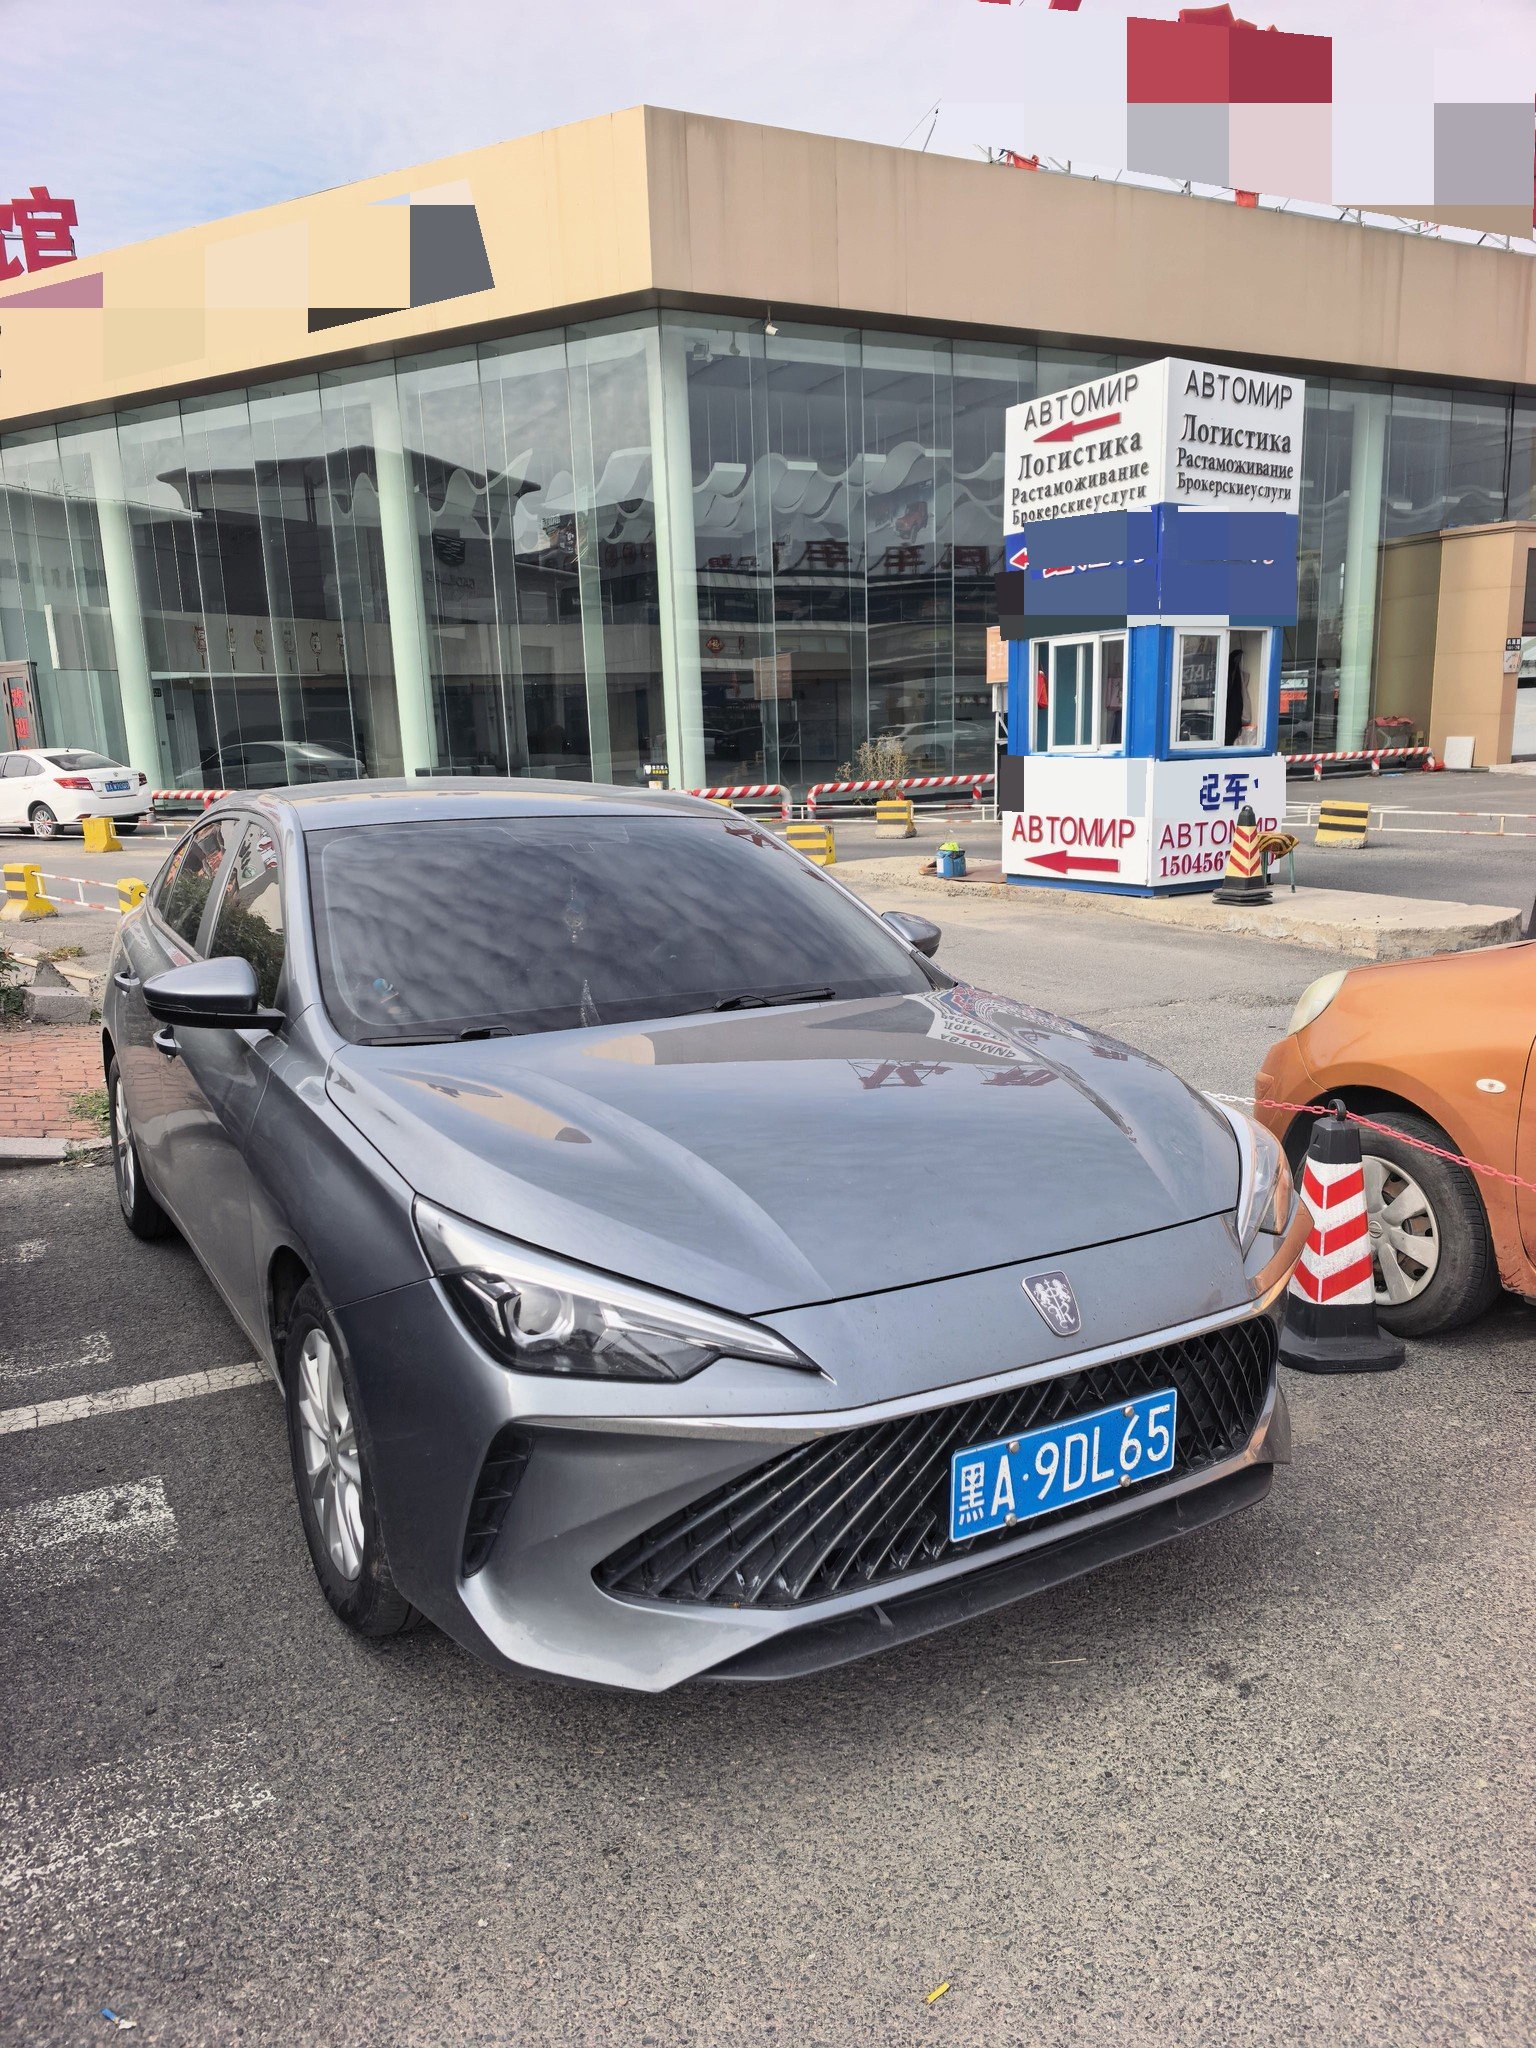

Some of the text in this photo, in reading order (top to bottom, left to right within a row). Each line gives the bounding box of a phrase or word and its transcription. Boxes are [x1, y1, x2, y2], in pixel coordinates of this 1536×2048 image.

[1024, 373, 1139, 431] АВТОМИР
[1185, 369, 1293, 410] АВТОМИР
[1181, 413, 1292, 453] Логистика
[1017, 431, 1143, 481] Логистика
[1177, 447, 1294, 480] Растаможивание
[1011, 461, 1150, 506] Растаможивание
[1011, 815, 1136, 848] АВТОМИР
